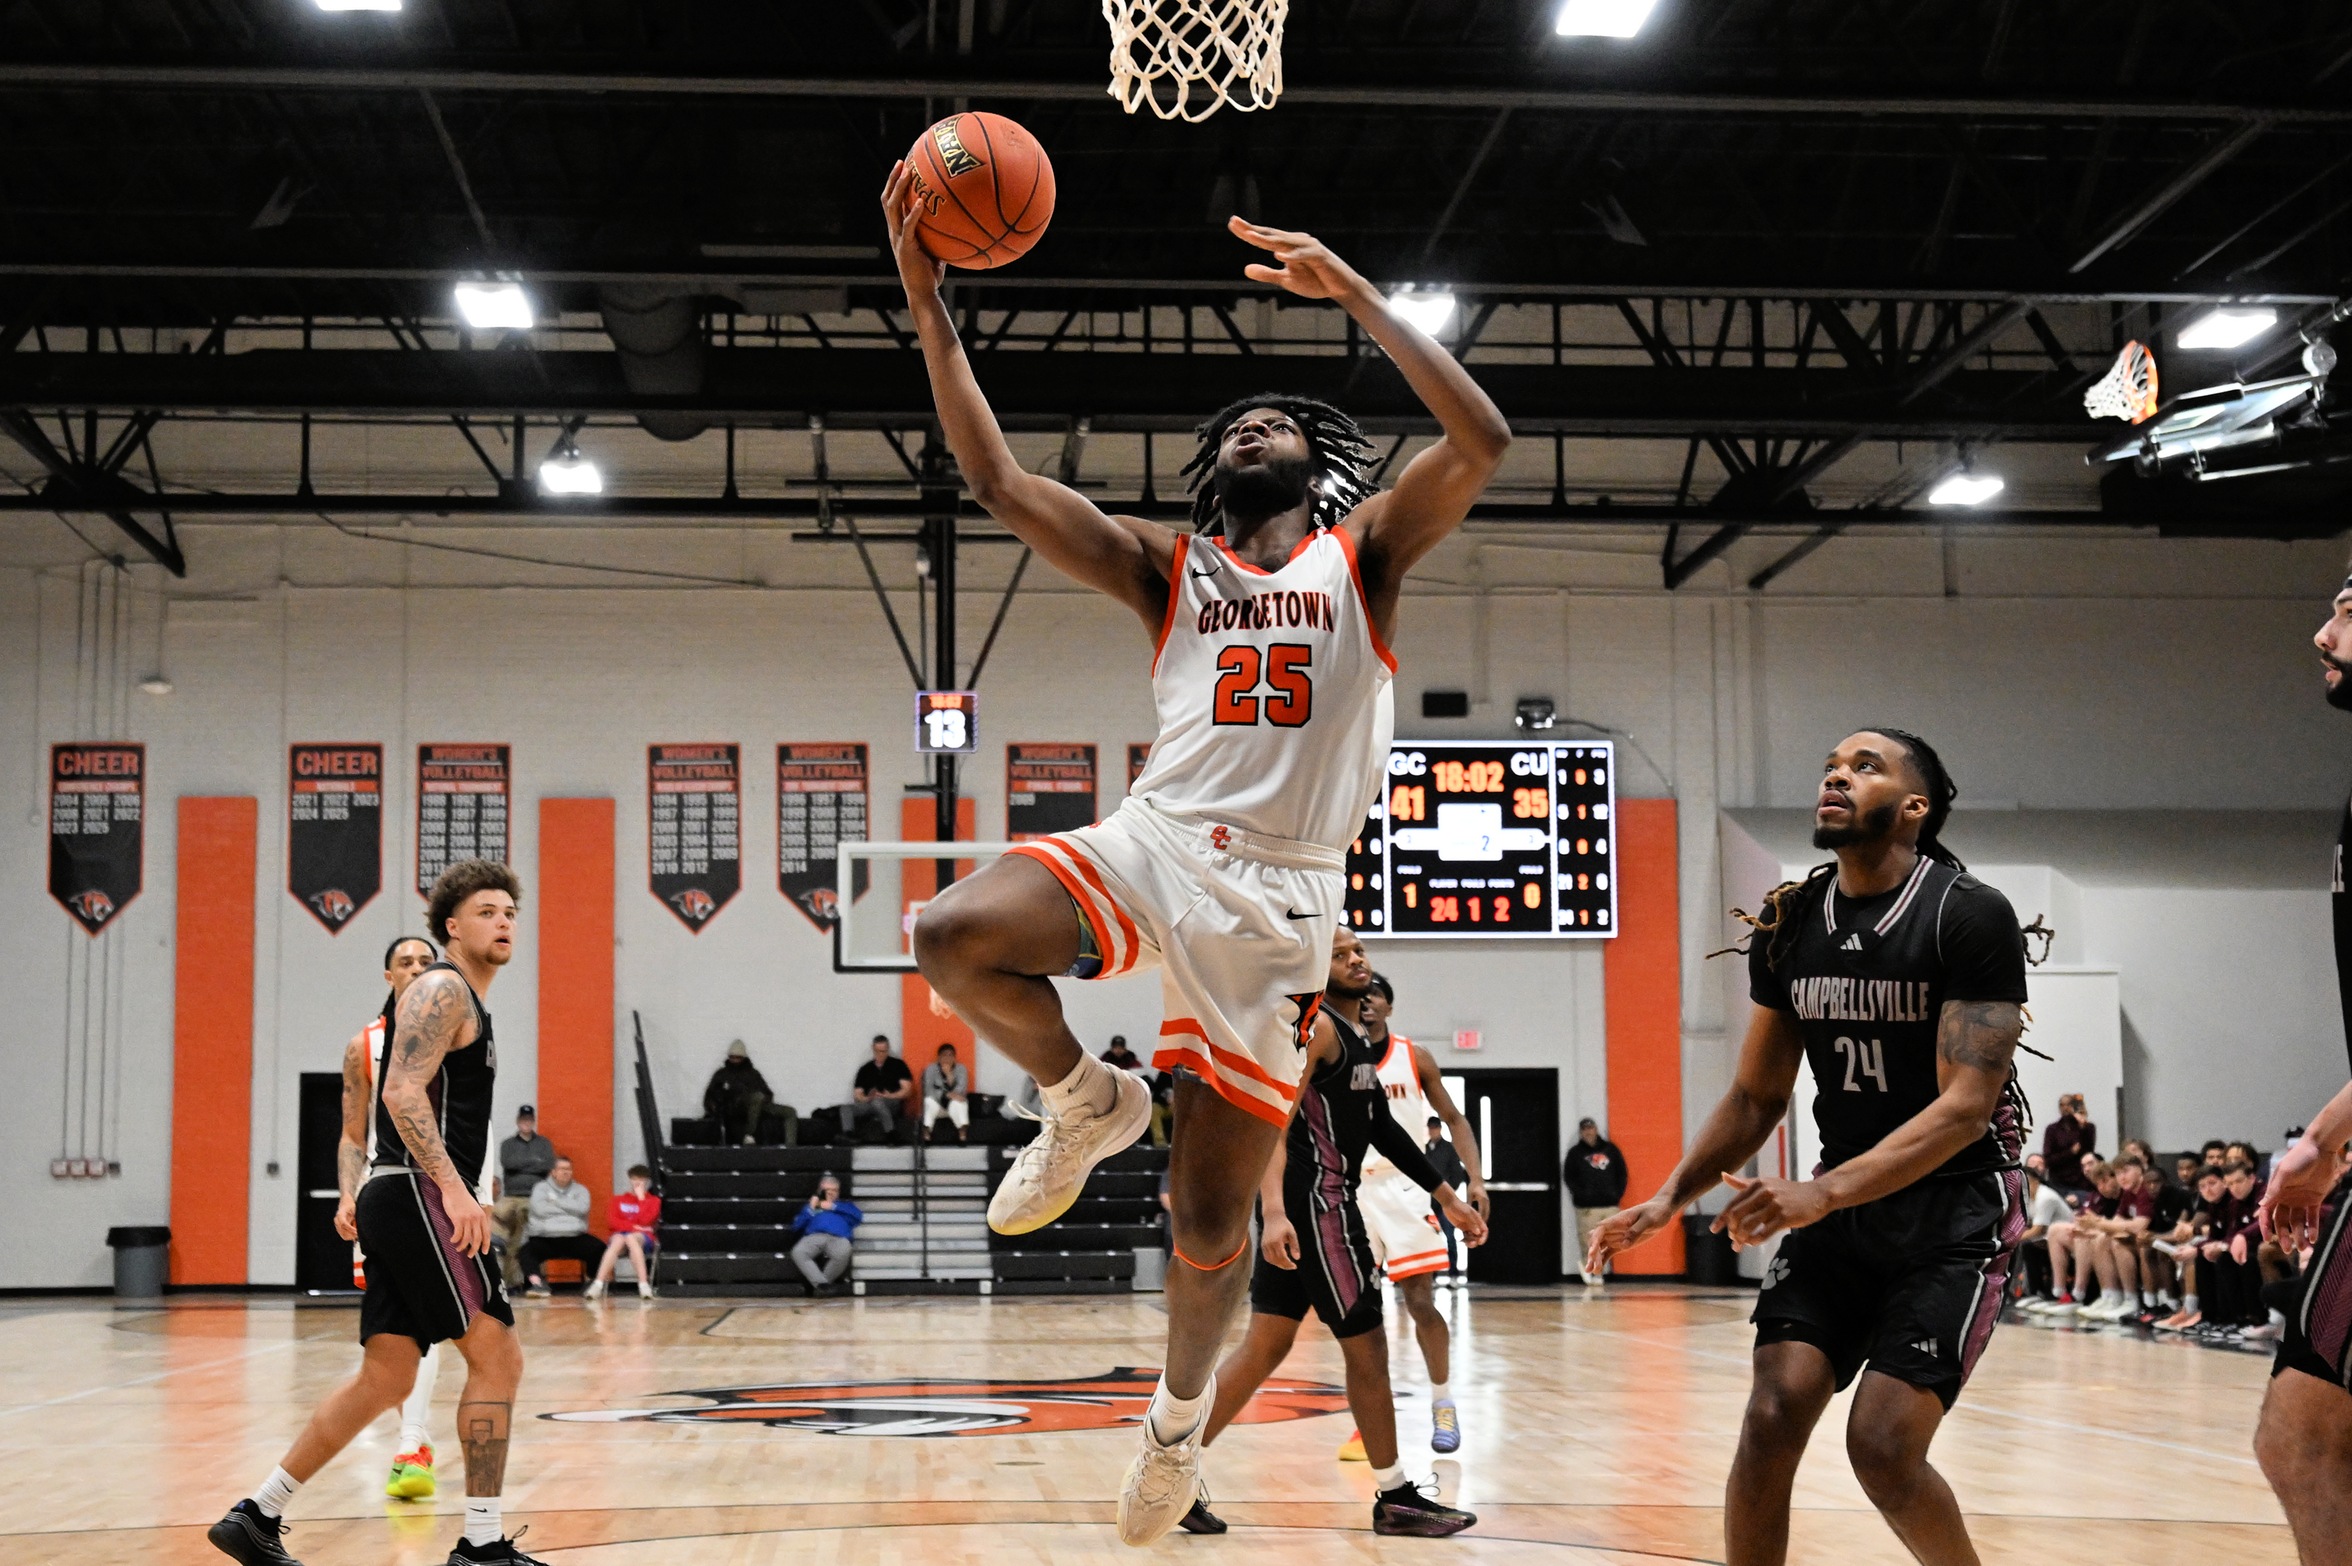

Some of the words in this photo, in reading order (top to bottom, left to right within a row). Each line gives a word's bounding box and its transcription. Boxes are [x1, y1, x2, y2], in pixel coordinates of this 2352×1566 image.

[1197, 590, 1335, 635] GEORGETOWN
[1212, 643, 1313, 728] 25
[924, 709, 966, 748] 13
[57, 752, 139, 775] CHEER
[295, 751, 377, 776] CHEER
[1388, 752, 1427, 776] GC
[1432, 761, 1505, 793] 18:02
[1510, 752, 1549, 776] CU
[1390, 785, 1425, 821] 41
[1513, 788, 1548, 819] 35
[1402, 882, 1417, 909] 1
[1429, 896, 1459, 922] 24
[1466, 896, 1481, 922] 1
[1494, 896, 1510, 922] 2
[1523, 882, 1541, 909] 0
[1791, 976, 1929, 1022] CAMPBELLSVILLE
[1834, 1036, 1888, 1093] 24
